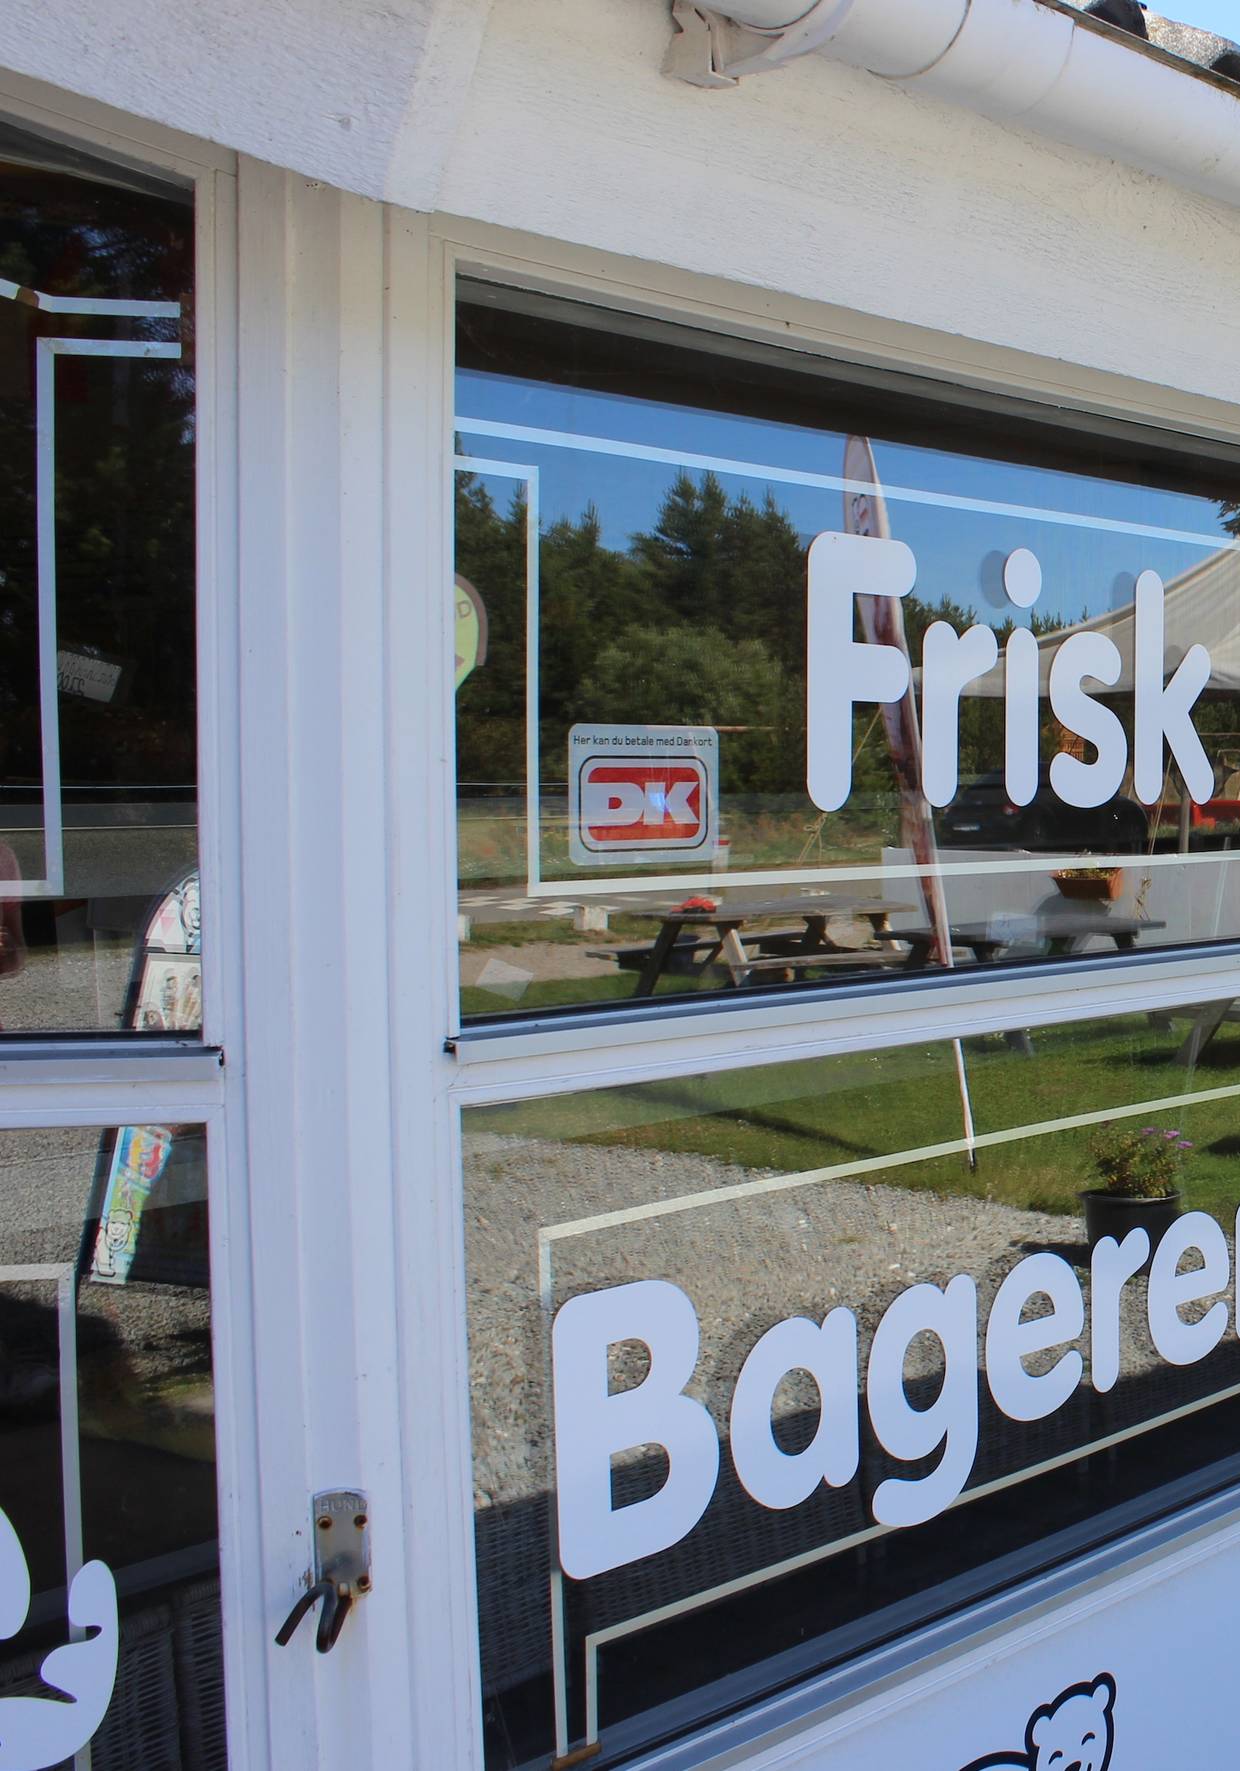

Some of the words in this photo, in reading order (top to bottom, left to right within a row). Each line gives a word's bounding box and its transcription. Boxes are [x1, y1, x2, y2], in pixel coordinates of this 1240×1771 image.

[807, 530, 1215, 812] Frisk
[573, 735, 591, 745] Her
[593, 735, 610, 745] kan
[612, 735, 623, 745] du
[625, 735, 654, 746] betale
[656, 736, 675, 746] med
[588, 781, 700, 826] DK
